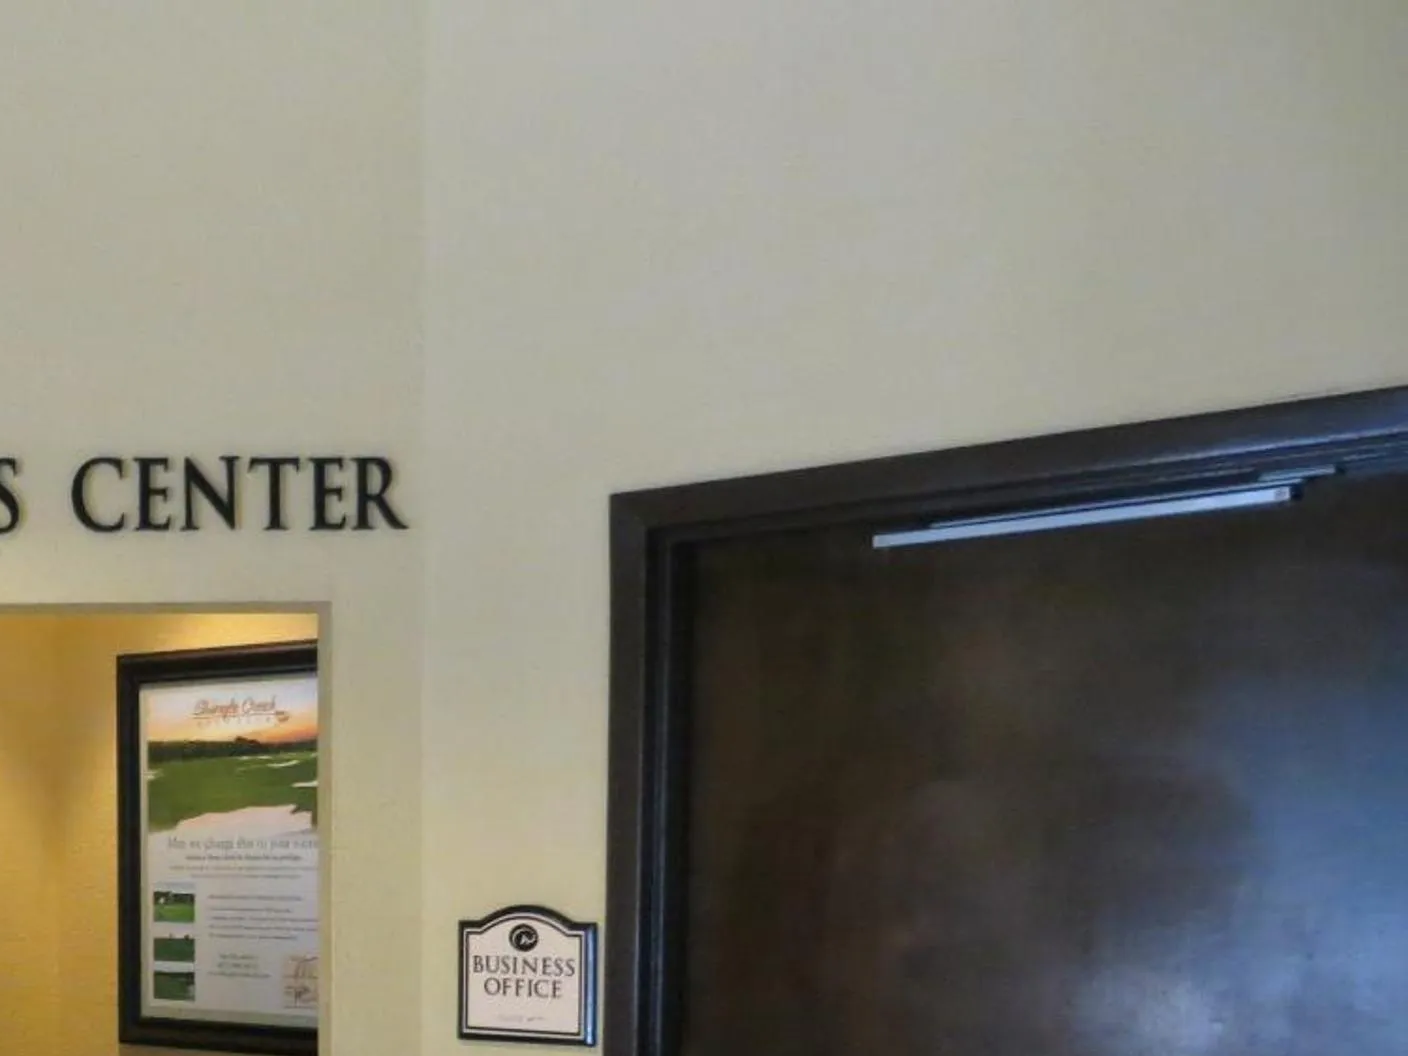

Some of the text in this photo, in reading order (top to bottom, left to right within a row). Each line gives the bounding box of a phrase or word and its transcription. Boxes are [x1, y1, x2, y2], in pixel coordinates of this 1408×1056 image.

[71, 455, 410, 533] CENTER
[472, 954, 576, 977] BUSINESS
[483, 977, 563, 999] OFFICE
